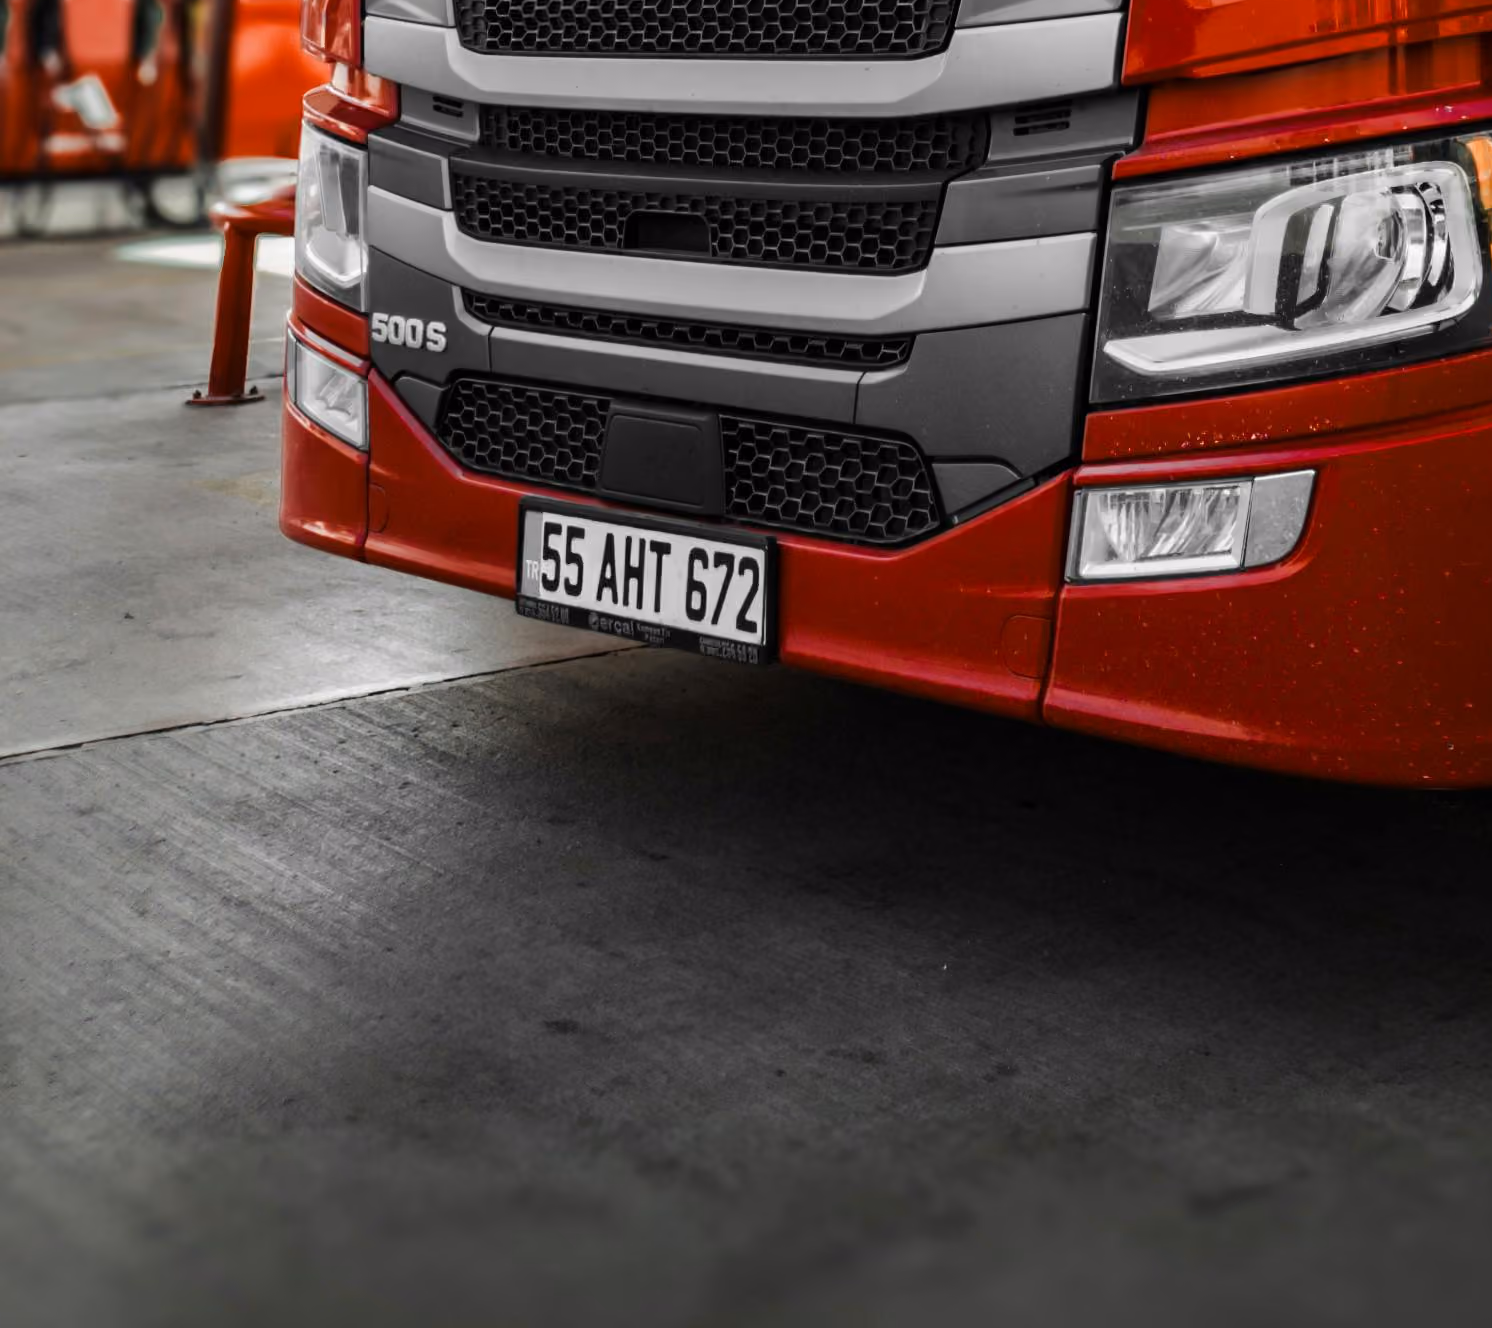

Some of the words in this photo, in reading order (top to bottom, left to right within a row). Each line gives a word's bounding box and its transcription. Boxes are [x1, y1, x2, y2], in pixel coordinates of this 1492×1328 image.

[525, 559, 539, 581] TR
[541, 521, 586, 597] 55
[596, 532, 671, 613] AHT
[686, 547, 760, 633] 672
